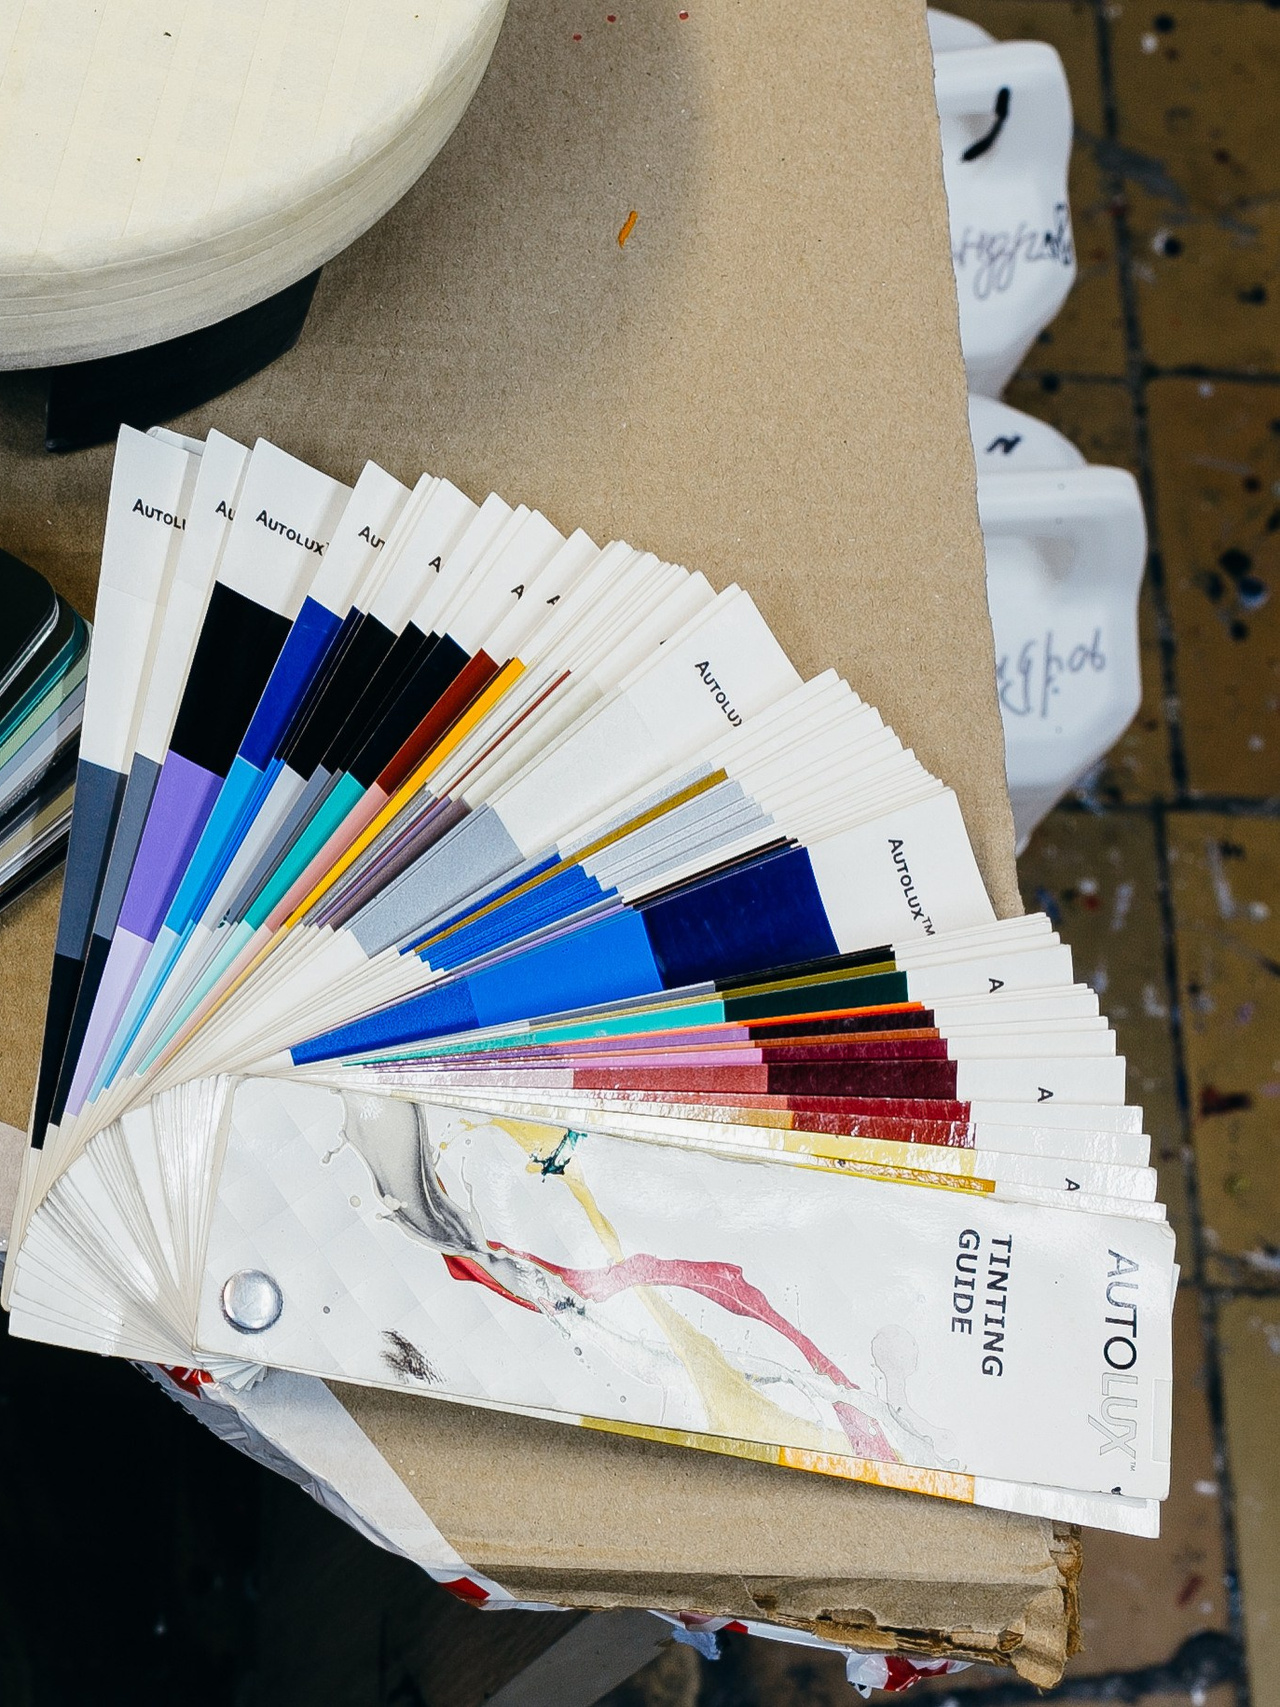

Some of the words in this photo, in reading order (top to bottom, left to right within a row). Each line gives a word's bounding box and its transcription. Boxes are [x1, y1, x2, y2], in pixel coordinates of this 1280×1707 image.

[255, 509, 329, 557] AUTOLUX
[951, 1228, 981, 1335] GUIDE
[981, 1234, 1013, 1377] TINTING
